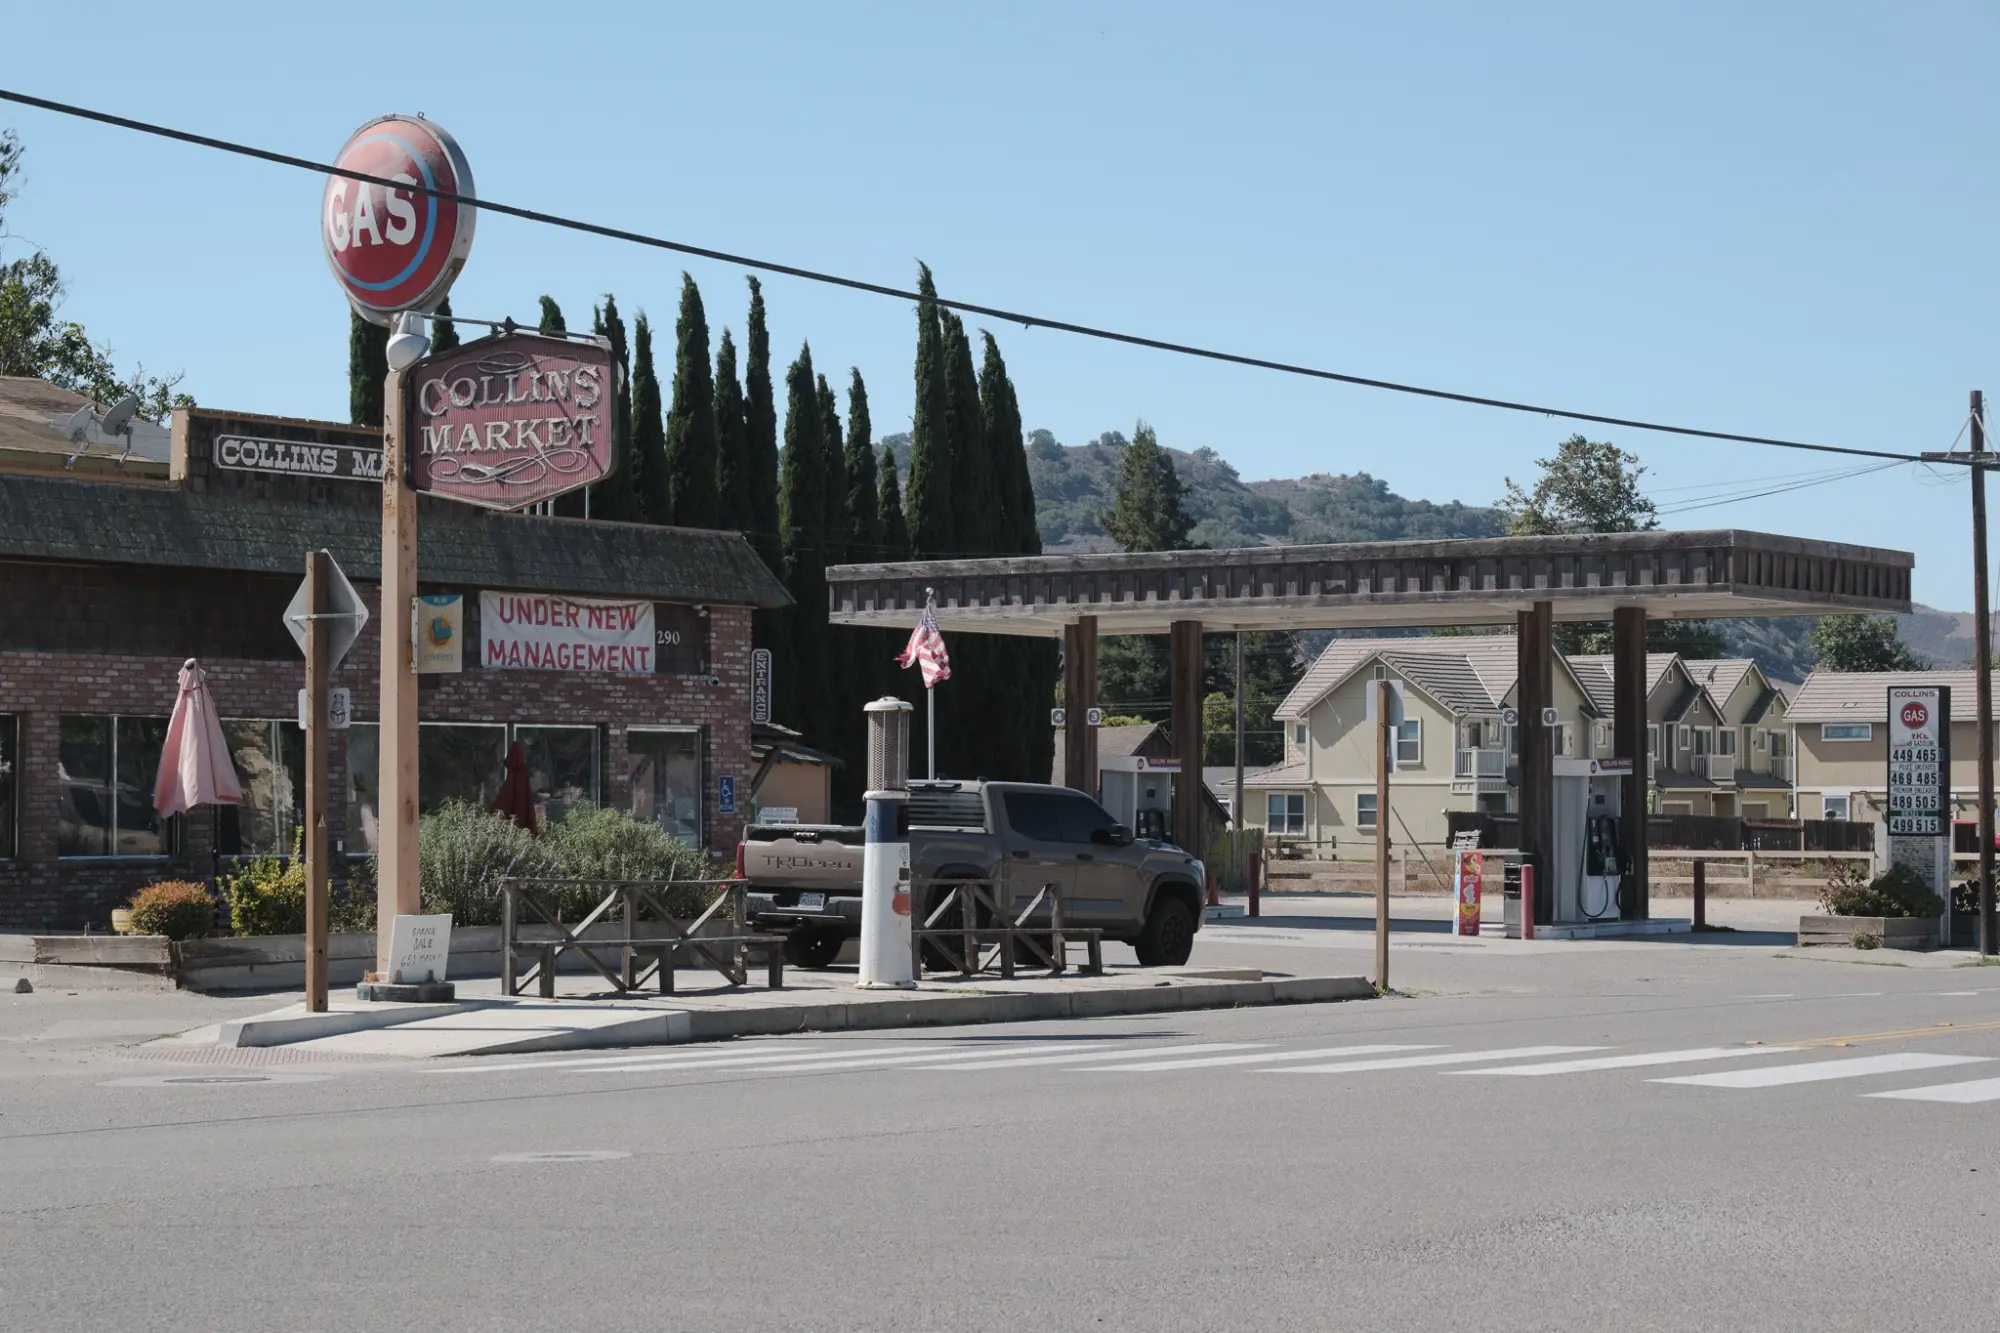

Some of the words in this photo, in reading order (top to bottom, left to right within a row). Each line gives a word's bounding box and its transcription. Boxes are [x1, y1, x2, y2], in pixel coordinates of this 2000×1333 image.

[329, 173, 417, 252] GAS
[420, 365, 601, 417] COLLINS
[421, 414, 600, 455] MARKET
[222, 439, 338, 473] COLLINS
[500, 597, 580, 628] UNDER
[588, 605, 638, 631] NEW
[656, 630, 681, 645] 290
[488, 638, 650, 672] MANAGEMENT
[755, 652, 767, 720] ENTRANCE
[1894, 690, 1936, 698] COLLINS
[1903, 710, 1925, 722] GAS
[1893, 749, 1913, 761] 449
[1916, 749, 1936, 761] 465
[1891, 772, 1912, 785] 469
[1916, 772, 1937, 785] 485
[1915, 796, 1936, 808] 505
[1893, 819, 1913, 831] 499
[1916, 819, 1936, 831] 515
[413, 938, 433, 950] SALE
